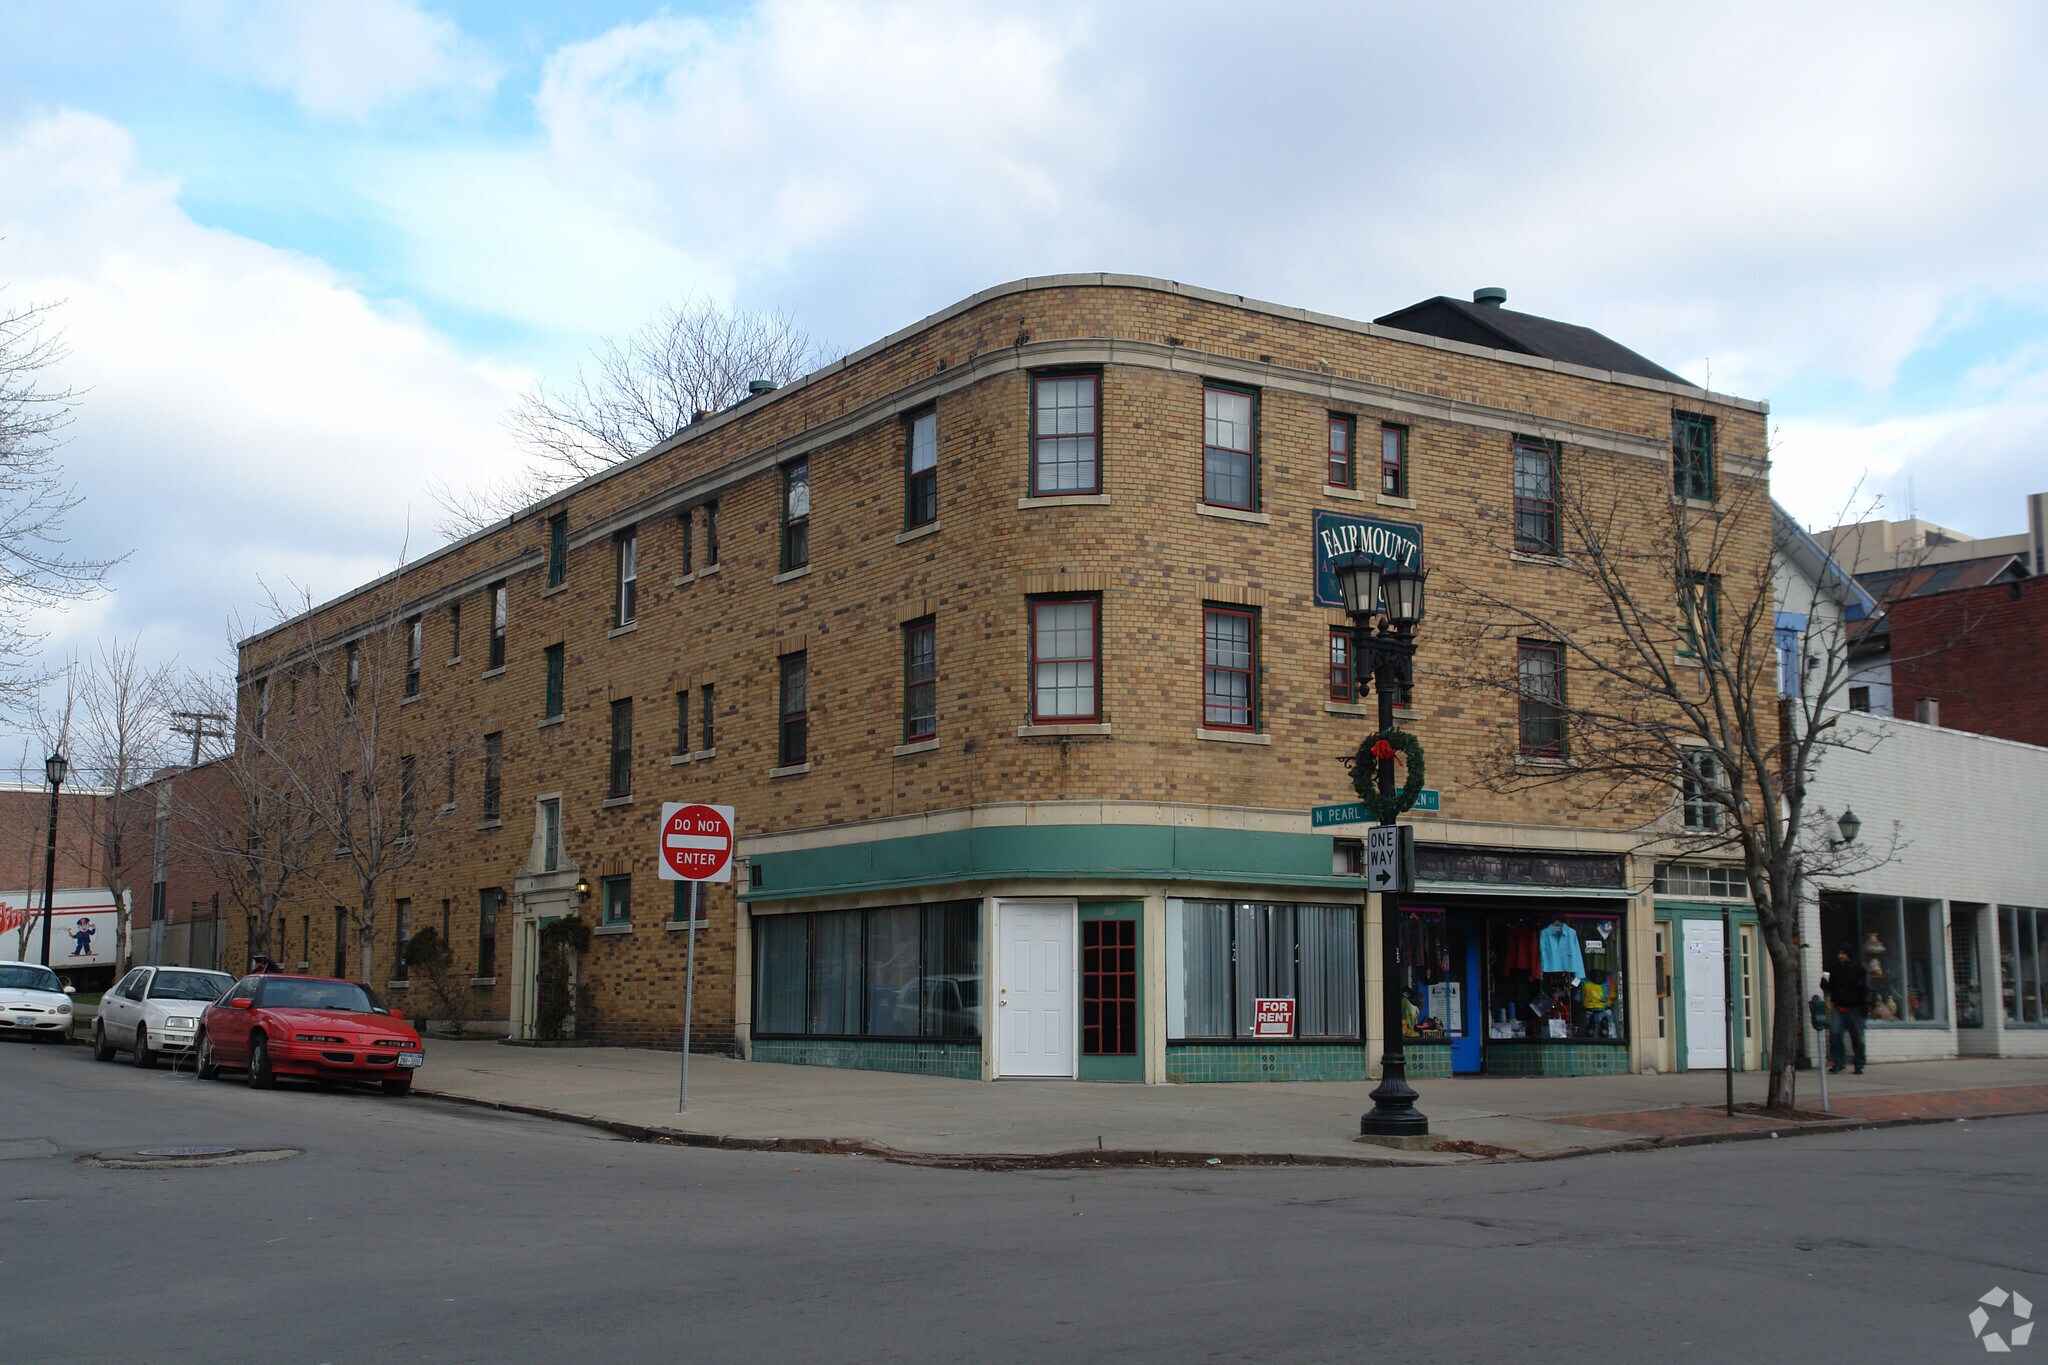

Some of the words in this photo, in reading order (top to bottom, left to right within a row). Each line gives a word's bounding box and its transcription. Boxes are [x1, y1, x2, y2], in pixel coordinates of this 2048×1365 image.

[1321, 525, 1416, 567] FAIRMOUNT
[1316, 810, 1323, 823] N
[1328, 807, 1361, 822] PEARL
[674, 818, 691, 831] DO
[697, 820, 721, 833] NOT
[1371, 832, 1394, 848] ONE
[676, 852, 716, 866] ENTER
[1371, 850, 1394, 866] WAY
[1262, 1001, 1288, 1012] FOR
[1258, 1012, 1292, 1022] RENT
